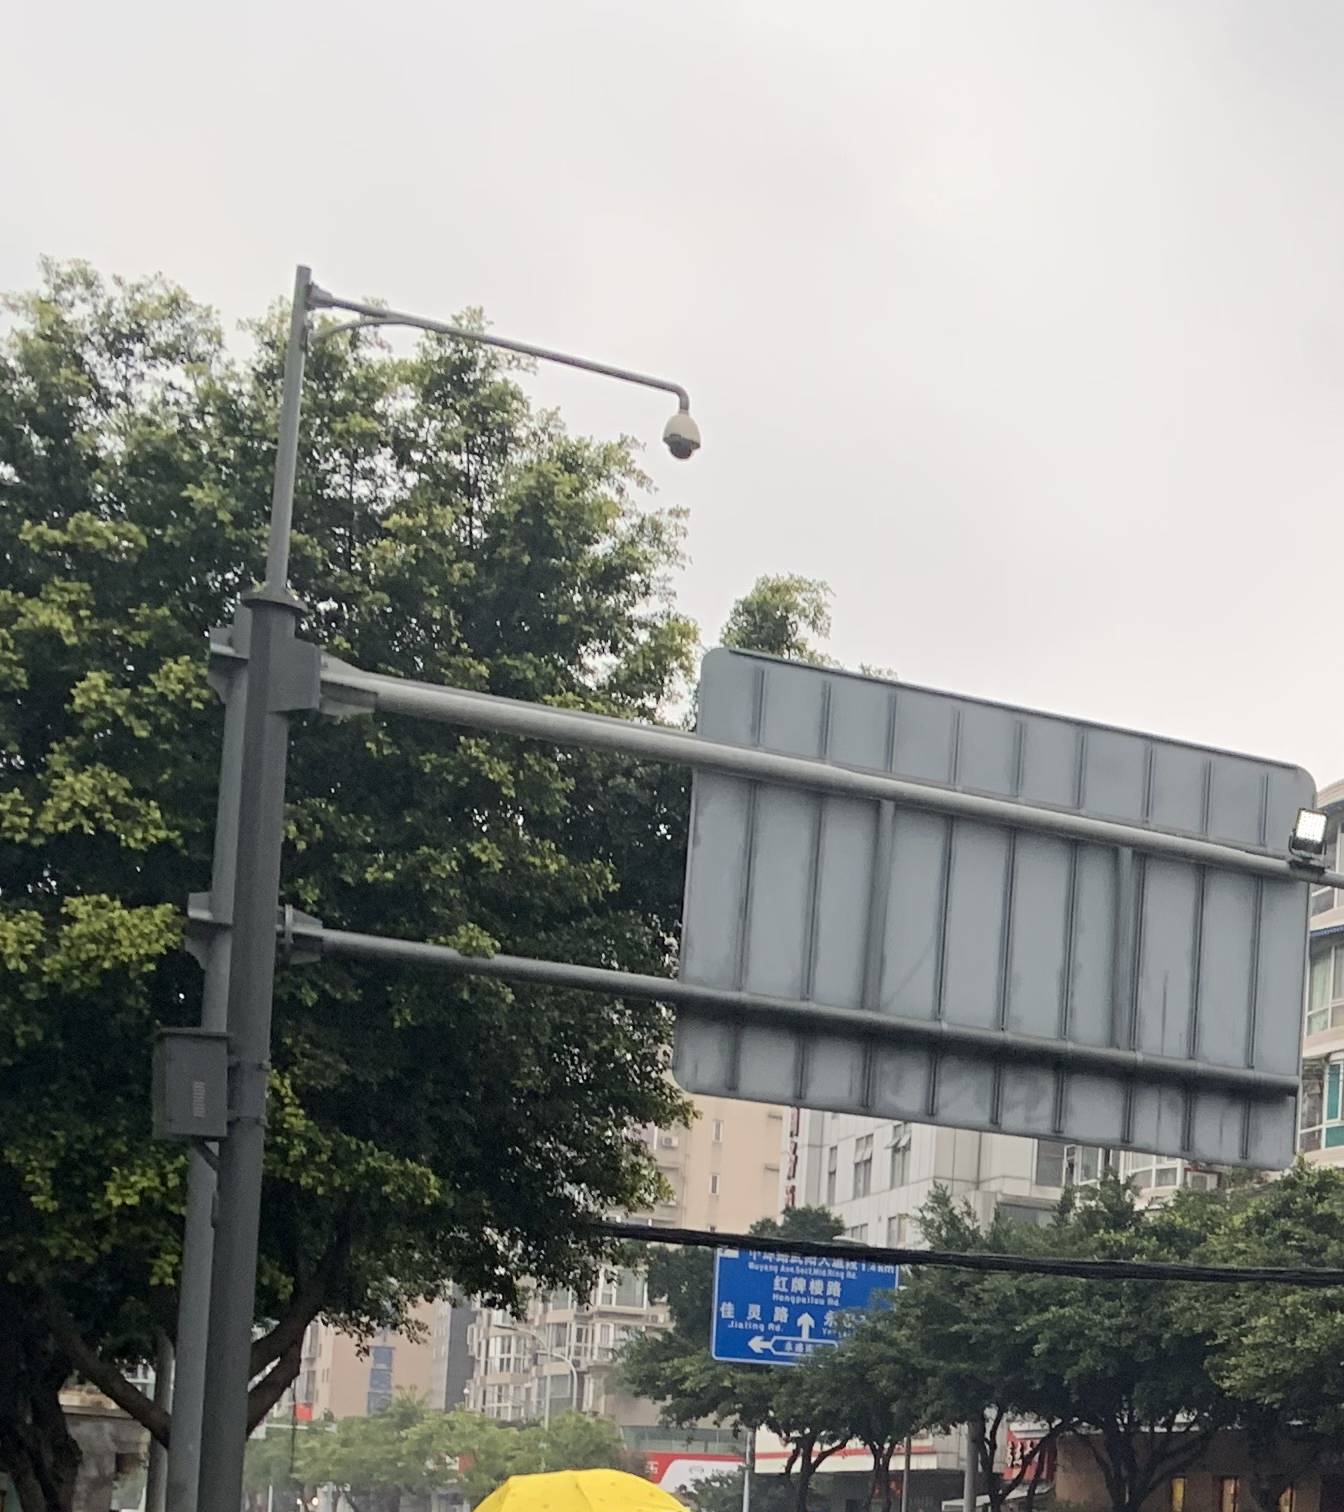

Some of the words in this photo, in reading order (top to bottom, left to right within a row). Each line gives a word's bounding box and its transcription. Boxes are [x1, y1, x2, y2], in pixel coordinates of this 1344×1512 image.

[773, 1275, 841, 1298] 红牌楼路
[720, 1301, 789, 1323] 佳灵路
